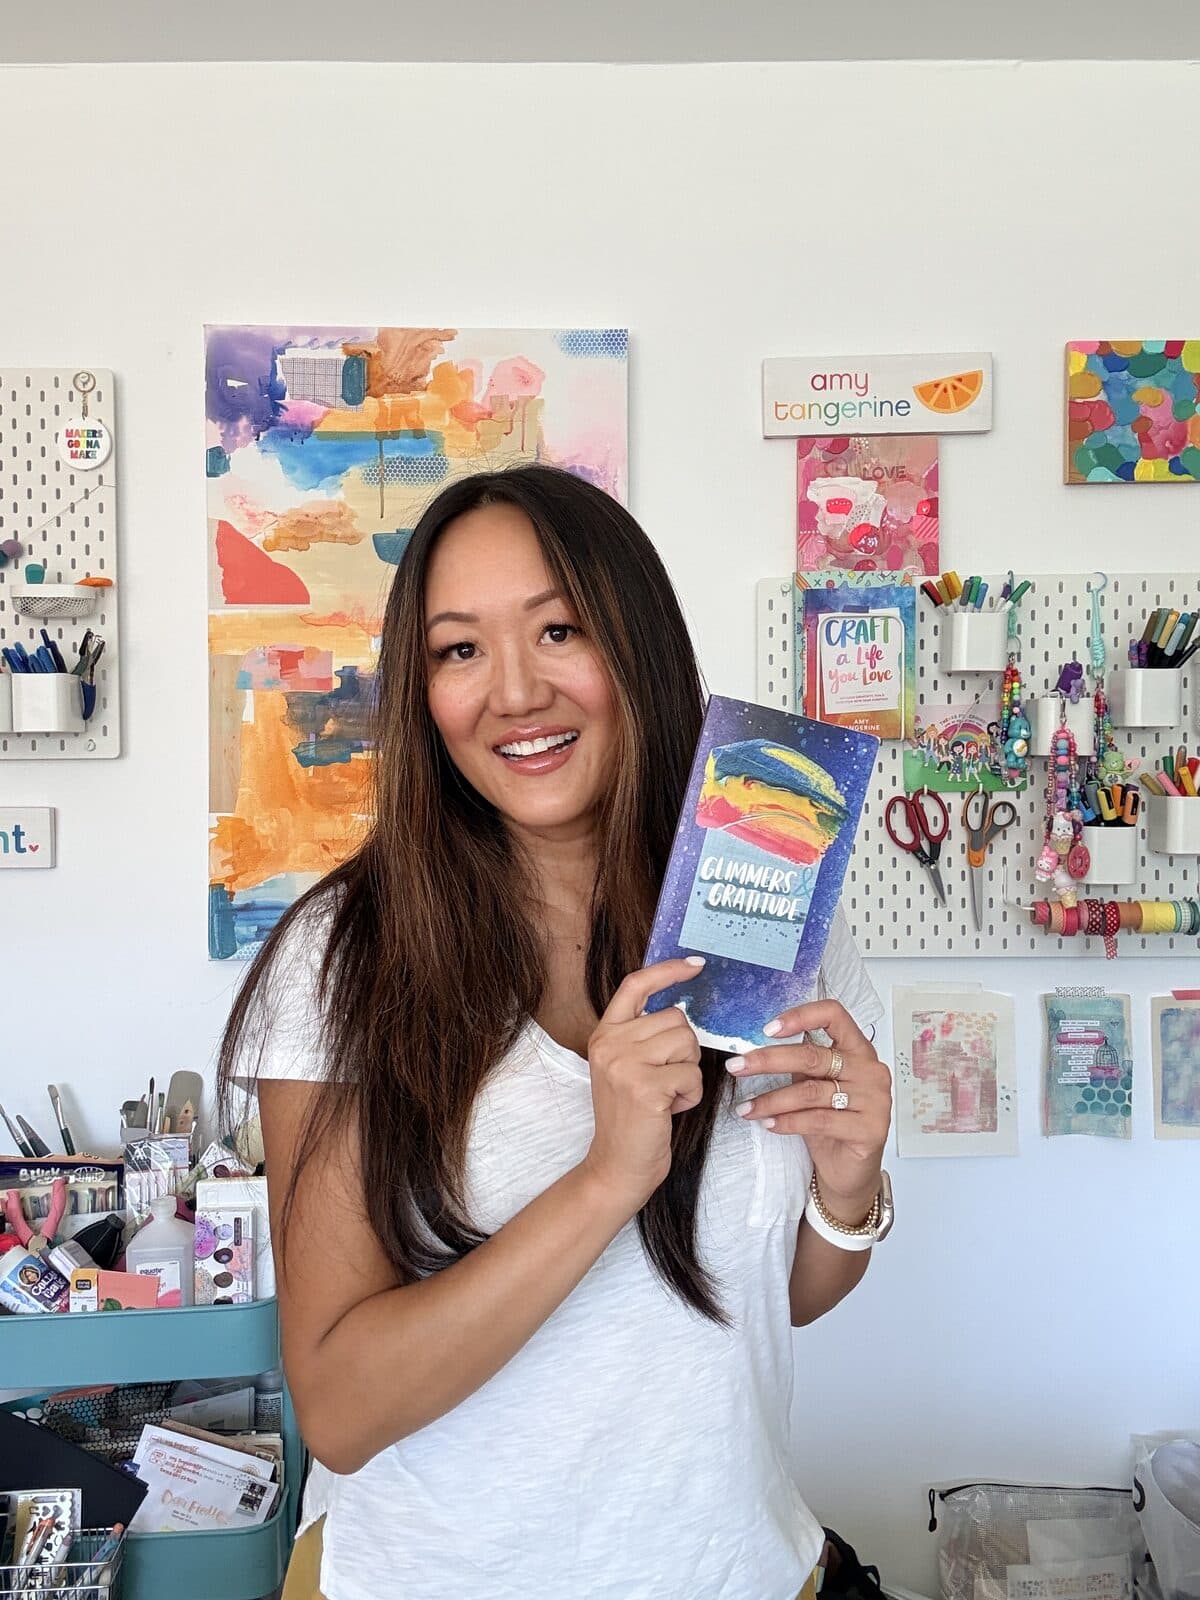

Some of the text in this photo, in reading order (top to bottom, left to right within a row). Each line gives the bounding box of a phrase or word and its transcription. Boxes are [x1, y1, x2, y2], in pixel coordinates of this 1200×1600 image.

[810, 372, 869, 397] amy
[774, 396, 911, 426] tangerine
[65, 429, 103, 438] MAKERS
[67, 440, 100, 449] GONNA
[70, 450, 97, 459] MAKE
[862, 465, 907, 480] LOVE
[825, 616, 891, 648] CRAFT
[836, 644, 884, 669] a Life
[863, 667, 893, 686] Love
[700, 856, 798, 893] GLIMMERS
[707, 882, 803, 921] GRATITUDE
